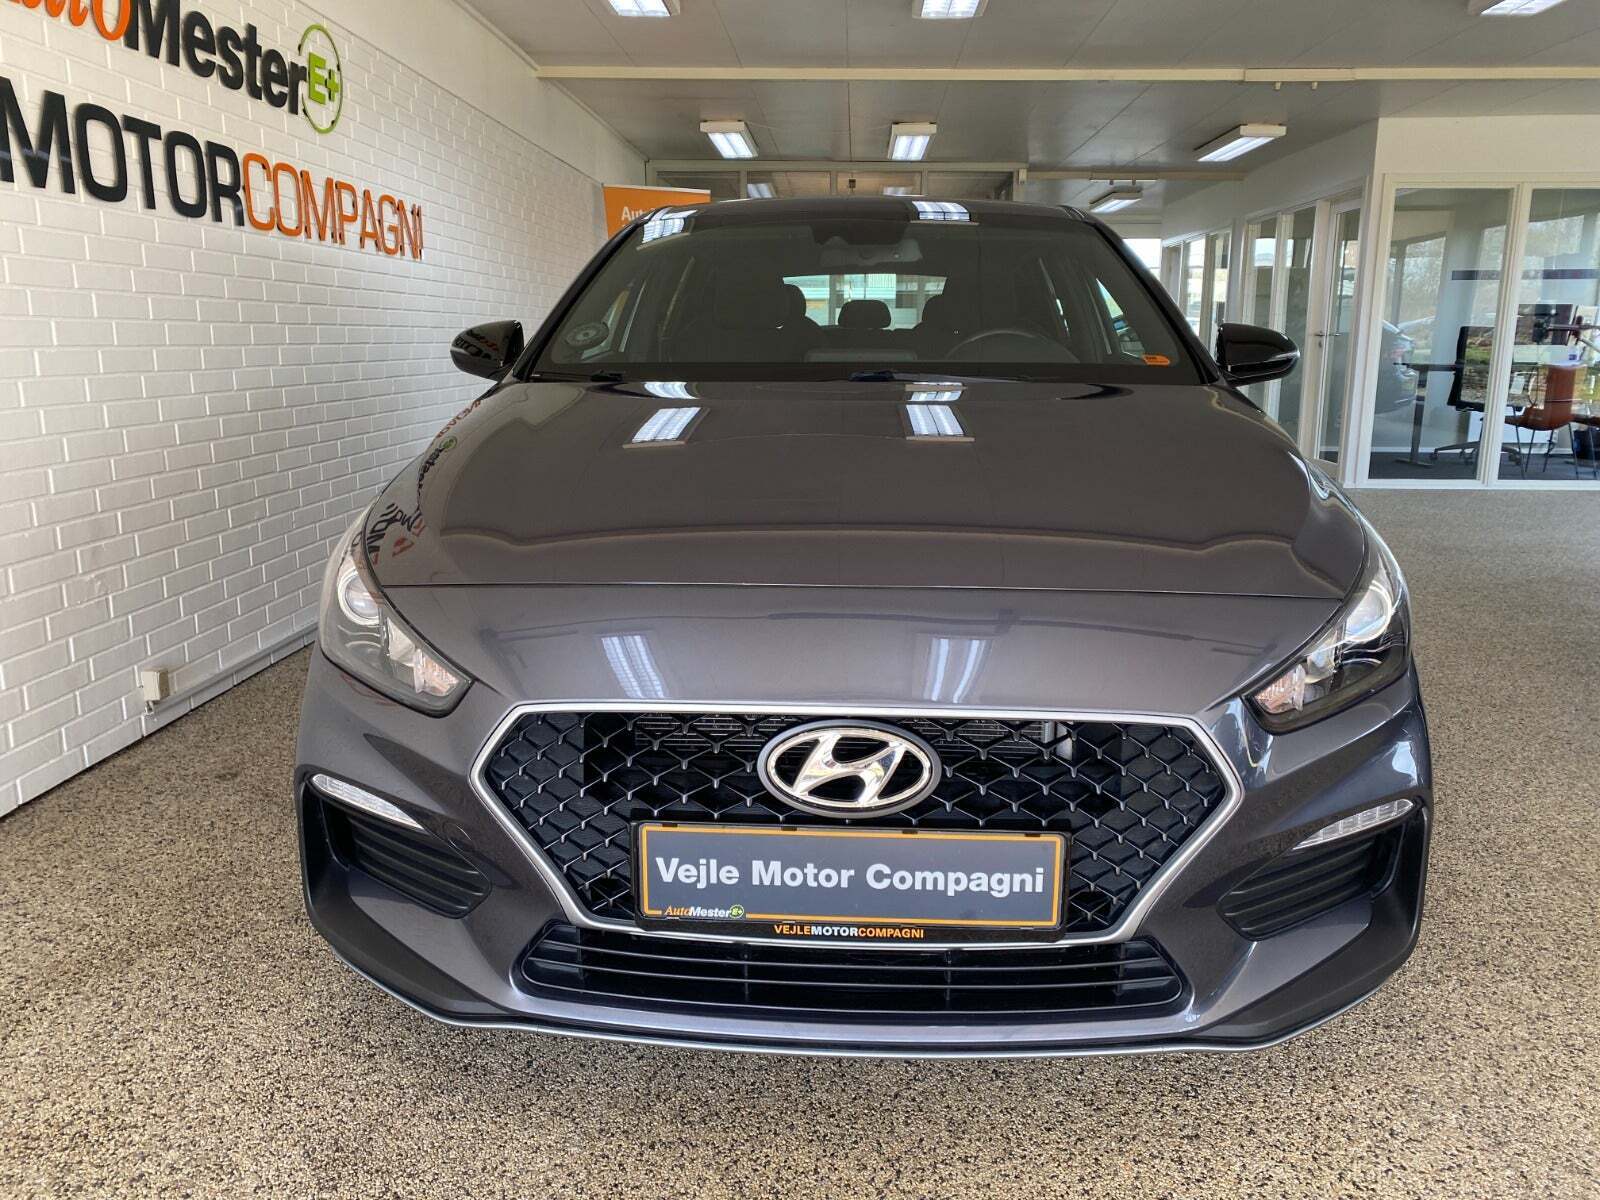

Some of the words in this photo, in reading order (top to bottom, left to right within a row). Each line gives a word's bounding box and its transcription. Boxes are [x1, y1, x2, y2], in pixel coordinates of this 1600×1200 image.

[655, 857, 740, 889] Vejle
[752, 860, 855, 888] Motor
[866, 863, 1045, 897] Compagni
